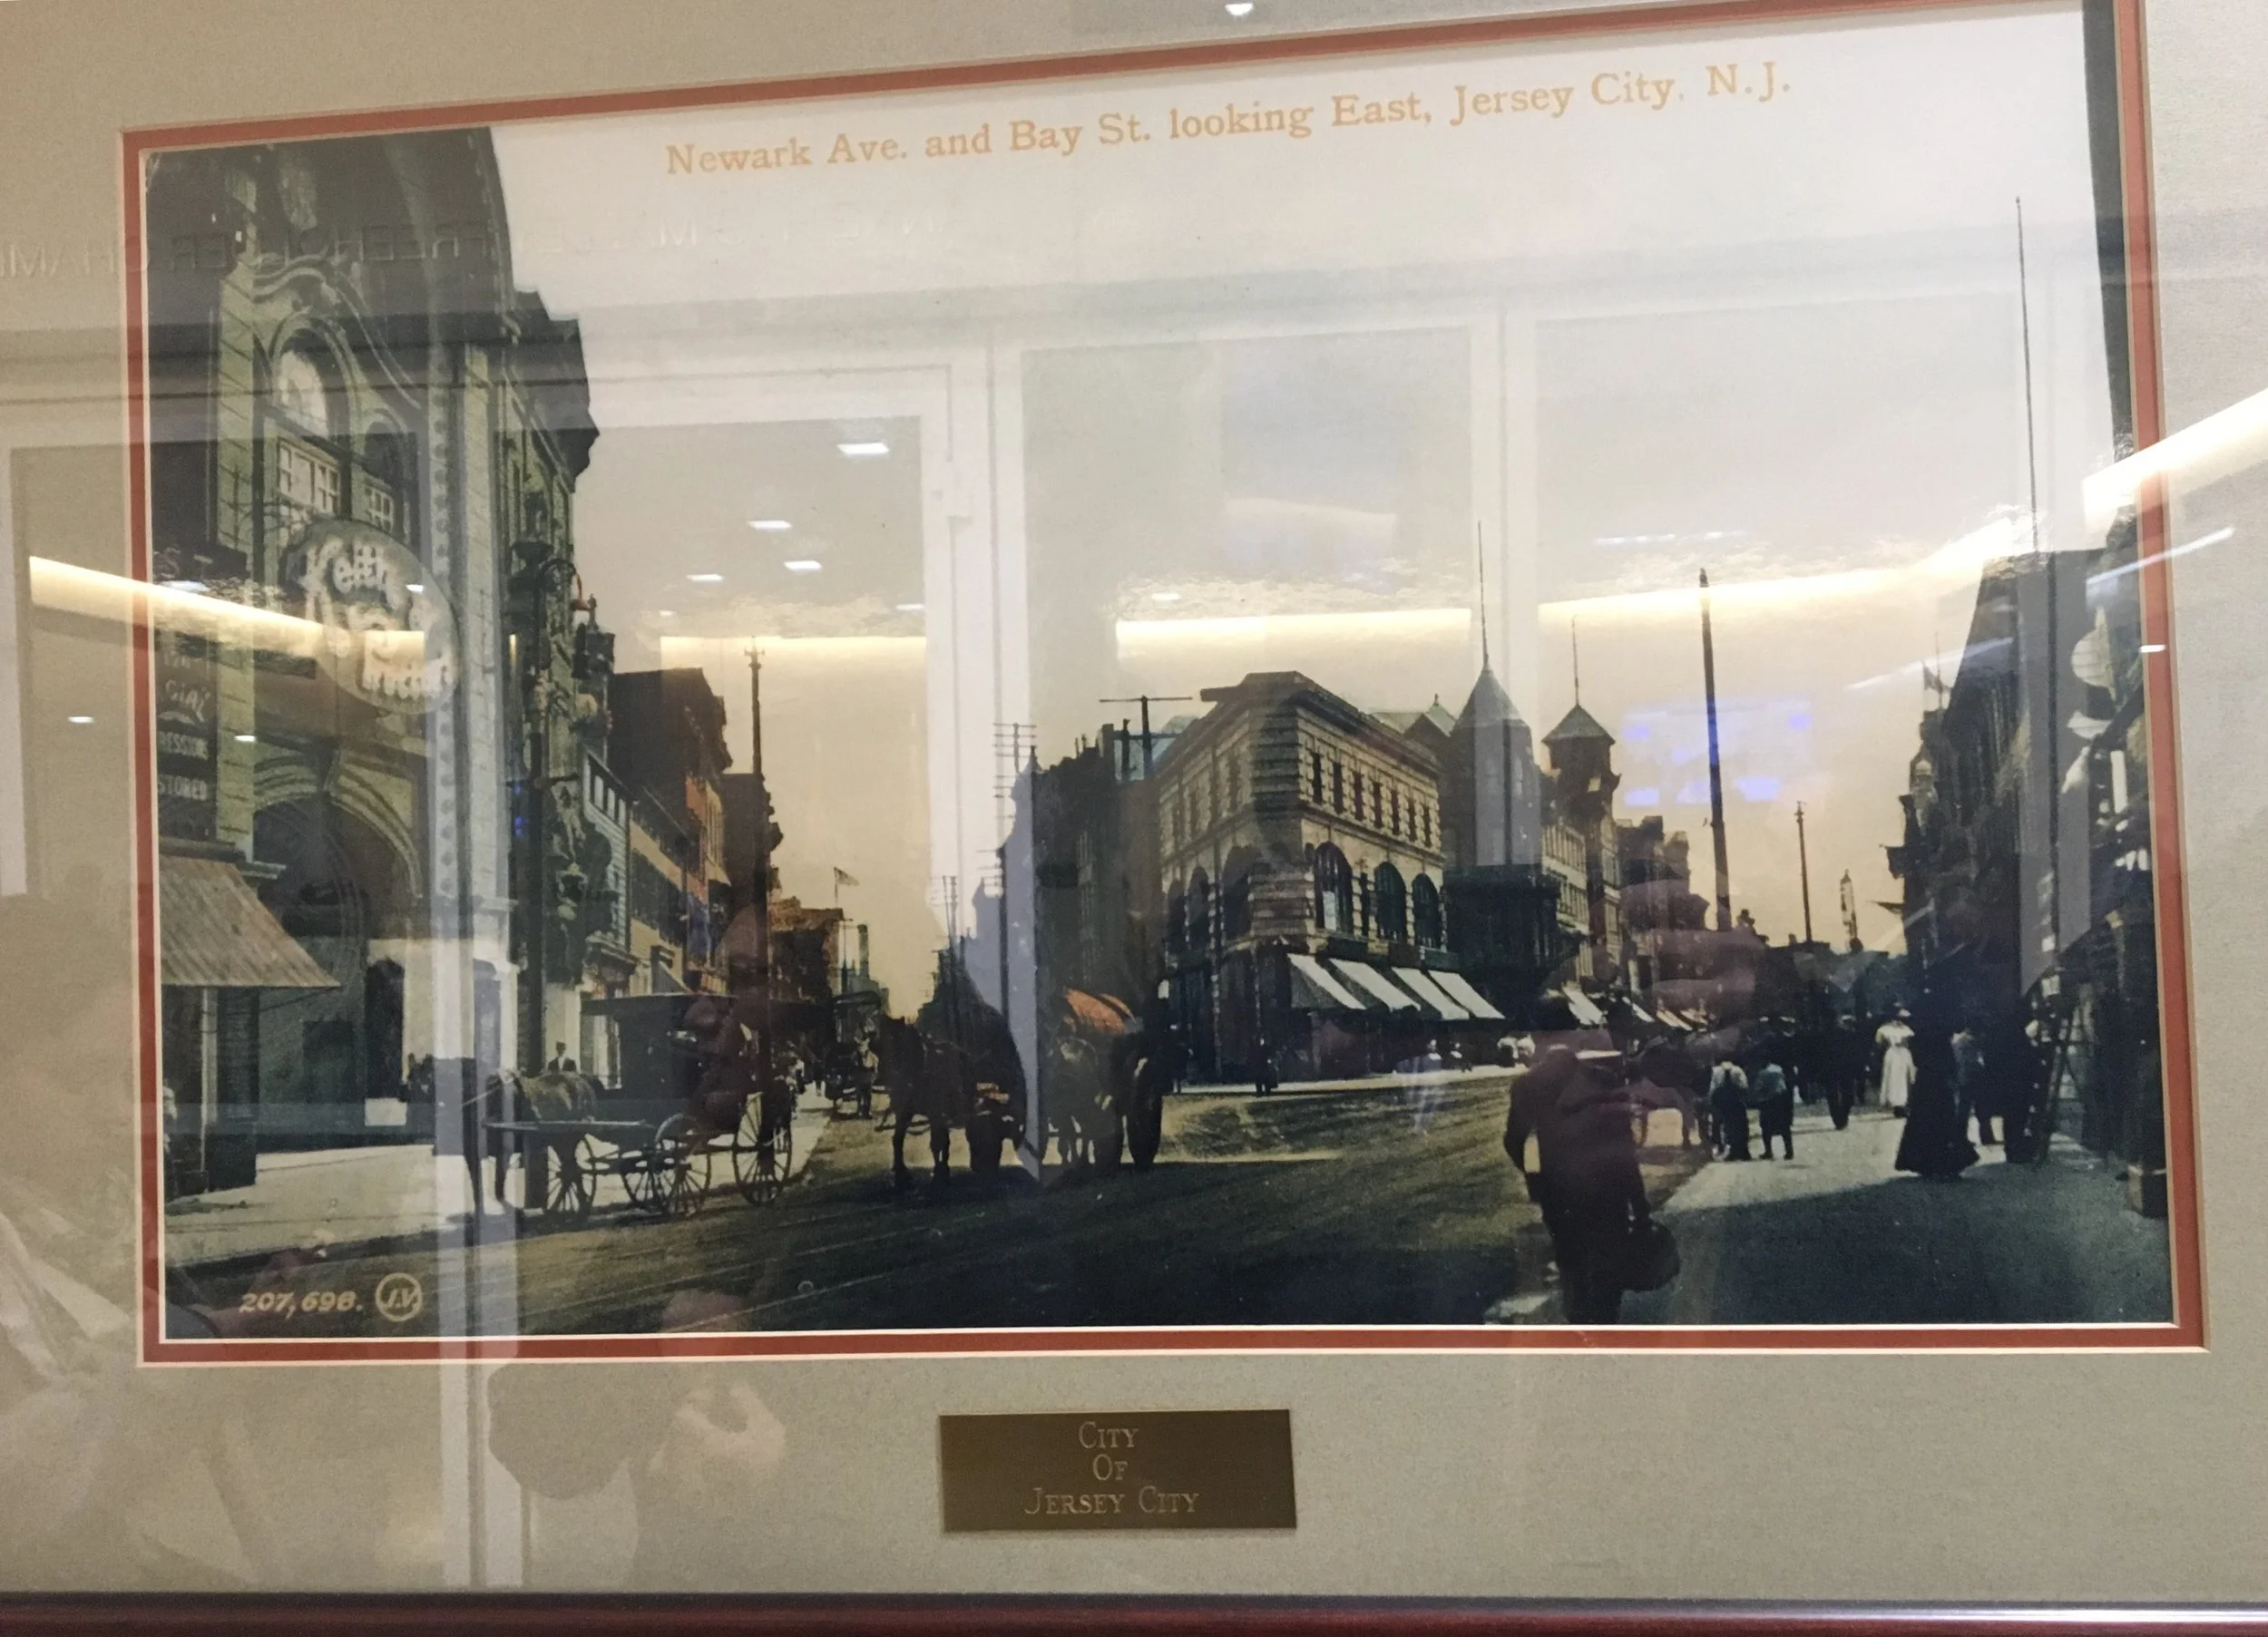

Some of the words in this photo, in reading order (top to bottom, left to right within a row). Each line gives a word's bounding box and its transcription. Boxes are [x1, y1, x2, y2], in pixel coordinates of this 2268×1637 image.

[667, 138, 812, 173] Newark
[826, 133, 908, 165] Ave.
[924, 122, 992, 158] and
[1008, 119, 1082, 157] Bay
[1098, 112, 1151, 146] St.
[1168, 101, 1314, 139] looking
[1331, 94, 1432, 130] East,
[1450, 84, 1573, 127] Jersey
[1706, 60, 1792, 102] N.J.
